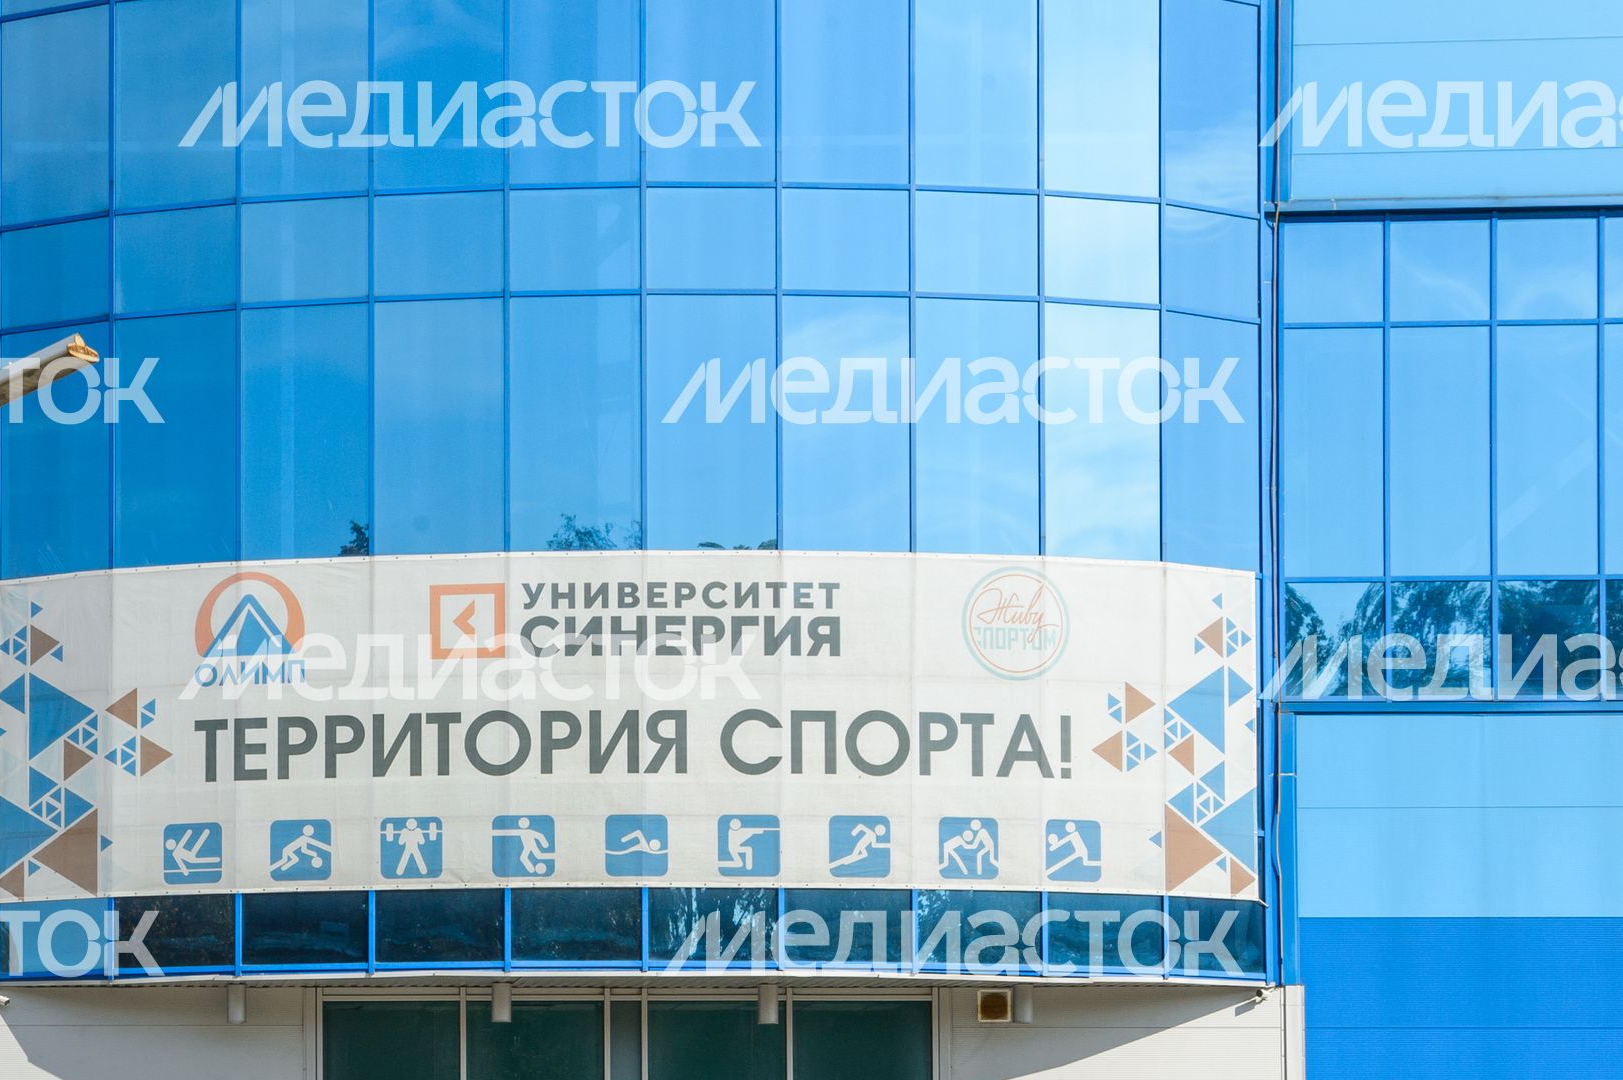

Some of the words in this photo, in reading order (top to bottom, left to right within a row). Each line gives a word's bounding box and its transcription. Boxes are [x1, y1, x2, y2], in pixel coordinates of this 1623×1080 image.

[521, 581, 841, 609] УНИВЕРСИТЕТ
[977, 584, 1059, 643] Живу
[520, 615, 841, 658] СИНЕРГИЯ
[195, 659, 305, 687] ОЛИМП
[194, 709, 688, 782] ТЕРРИТОРИЯ
[720, 709, 1073, 779] СПОРТА!
